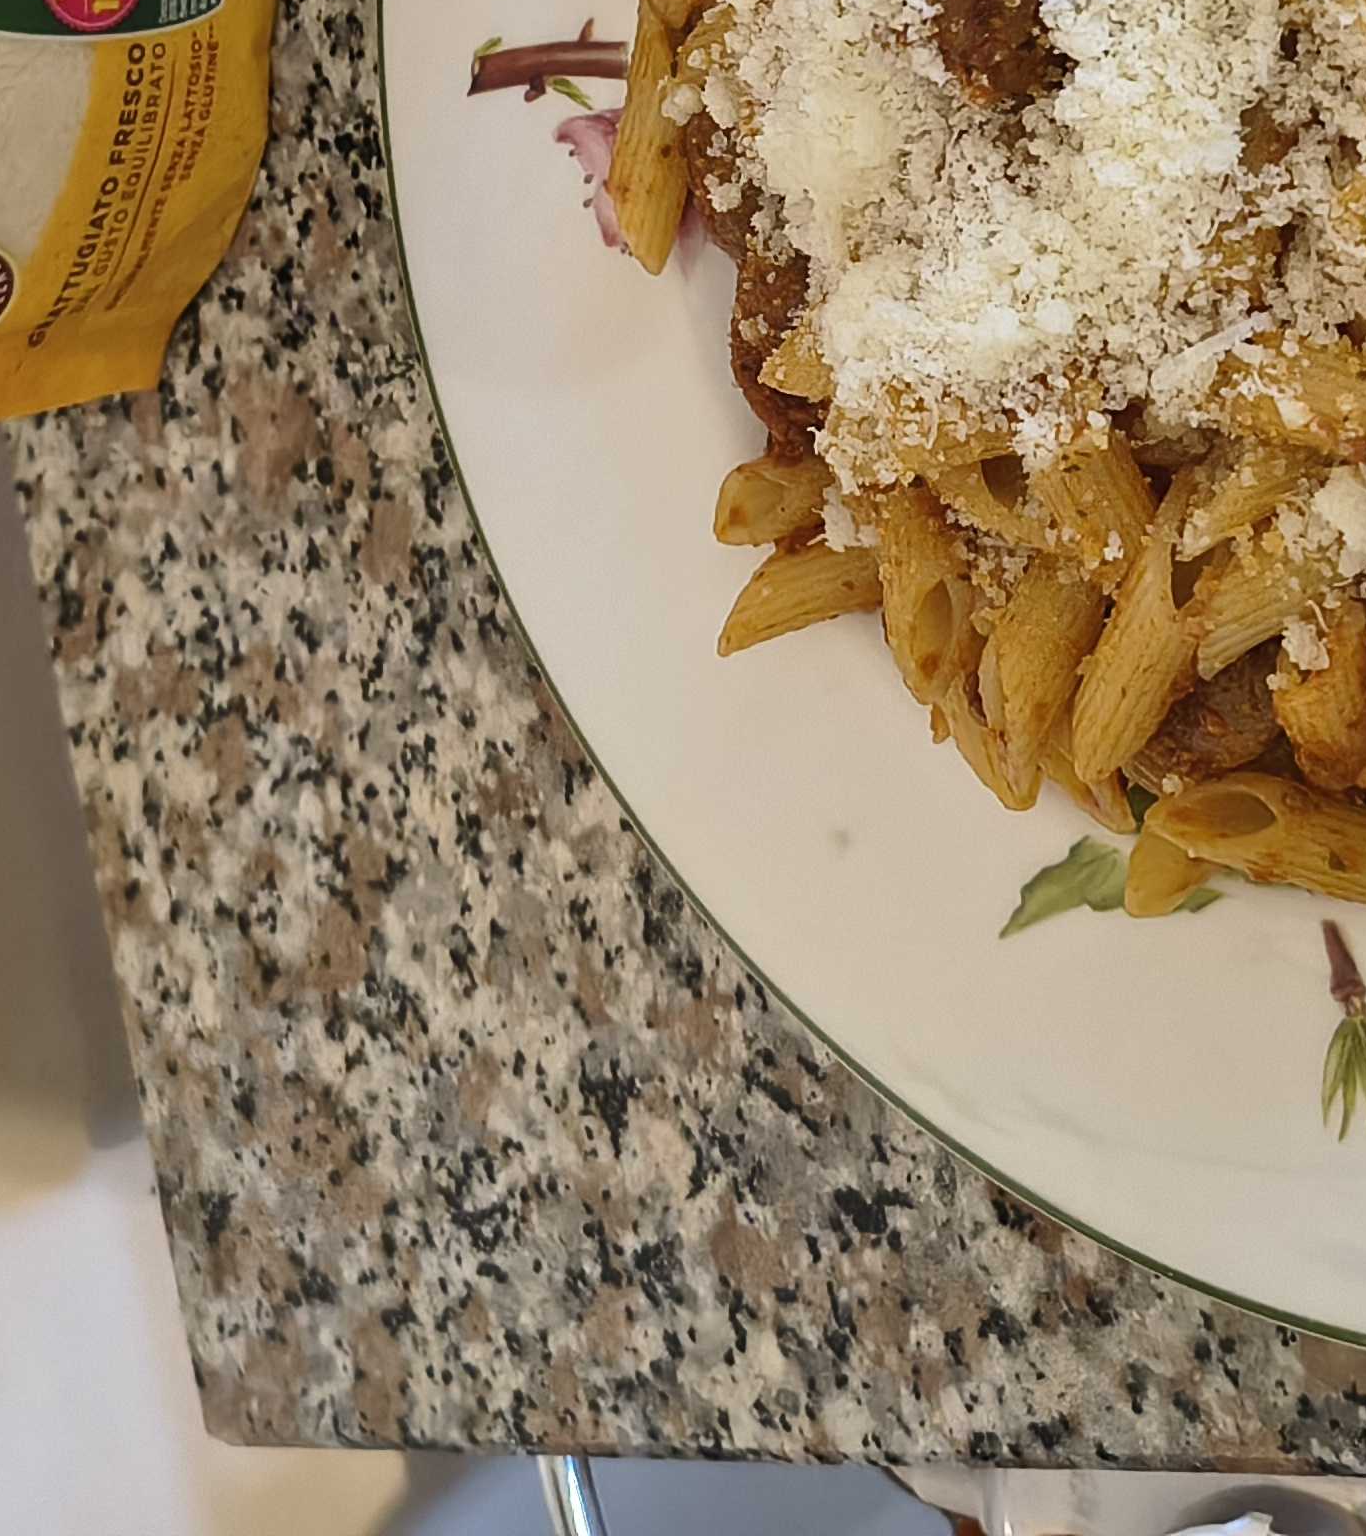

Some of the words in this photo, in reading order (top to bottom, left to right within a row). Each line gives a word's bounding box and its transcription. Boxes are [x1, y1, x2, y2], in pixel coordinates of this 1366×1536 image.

[90, 207, 130, 274] GUSTO
[120, 41, 167, 201] EQUILIBRATO
[107, 41, 147, 166] FRESCO
[160, 137, 188, 192] SENZA
